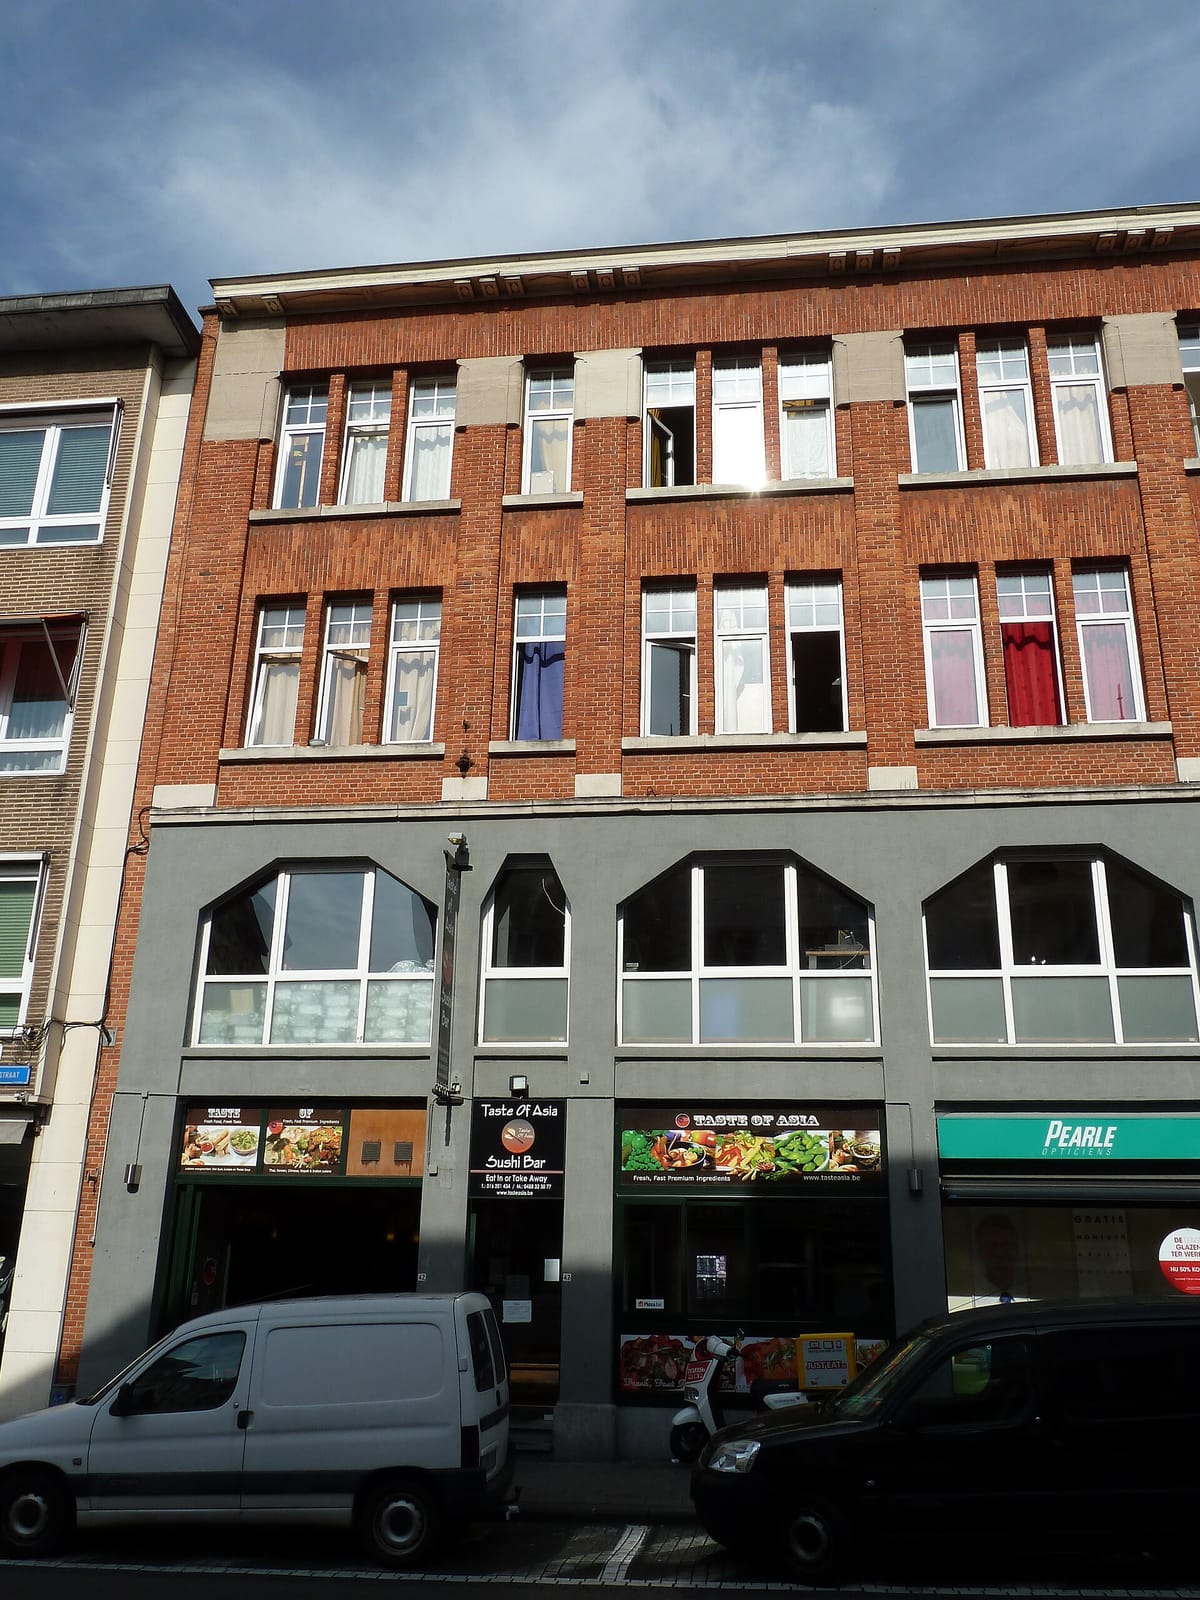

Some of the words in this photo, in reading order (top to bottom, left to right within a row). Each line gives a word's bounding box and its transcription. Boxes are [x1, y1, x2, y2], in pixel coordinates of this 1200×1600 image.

[481, 1104, 514, 1118] Taste
[516, 1104, 531, 1117] Of
[532, 1104, 558, 1116] Asia
[693, 1115, 748, 1126] TASTE
[751, 1115, 774, 1126] OF
[776, 1115, 820, 1126] ASIA
[1044, 1120, 1118, 1147] PEARLE
[1042, 1148, 1112, 1156] OPTICIENS
[485, 1155, 521, 1168] Sushi
[523, 1155, 546, 1168] Bar
[485, 1174, 496, 1182] Eat
[512, 1174, 528, 1182] Take
[529, 1174, 548, 1183] Away
